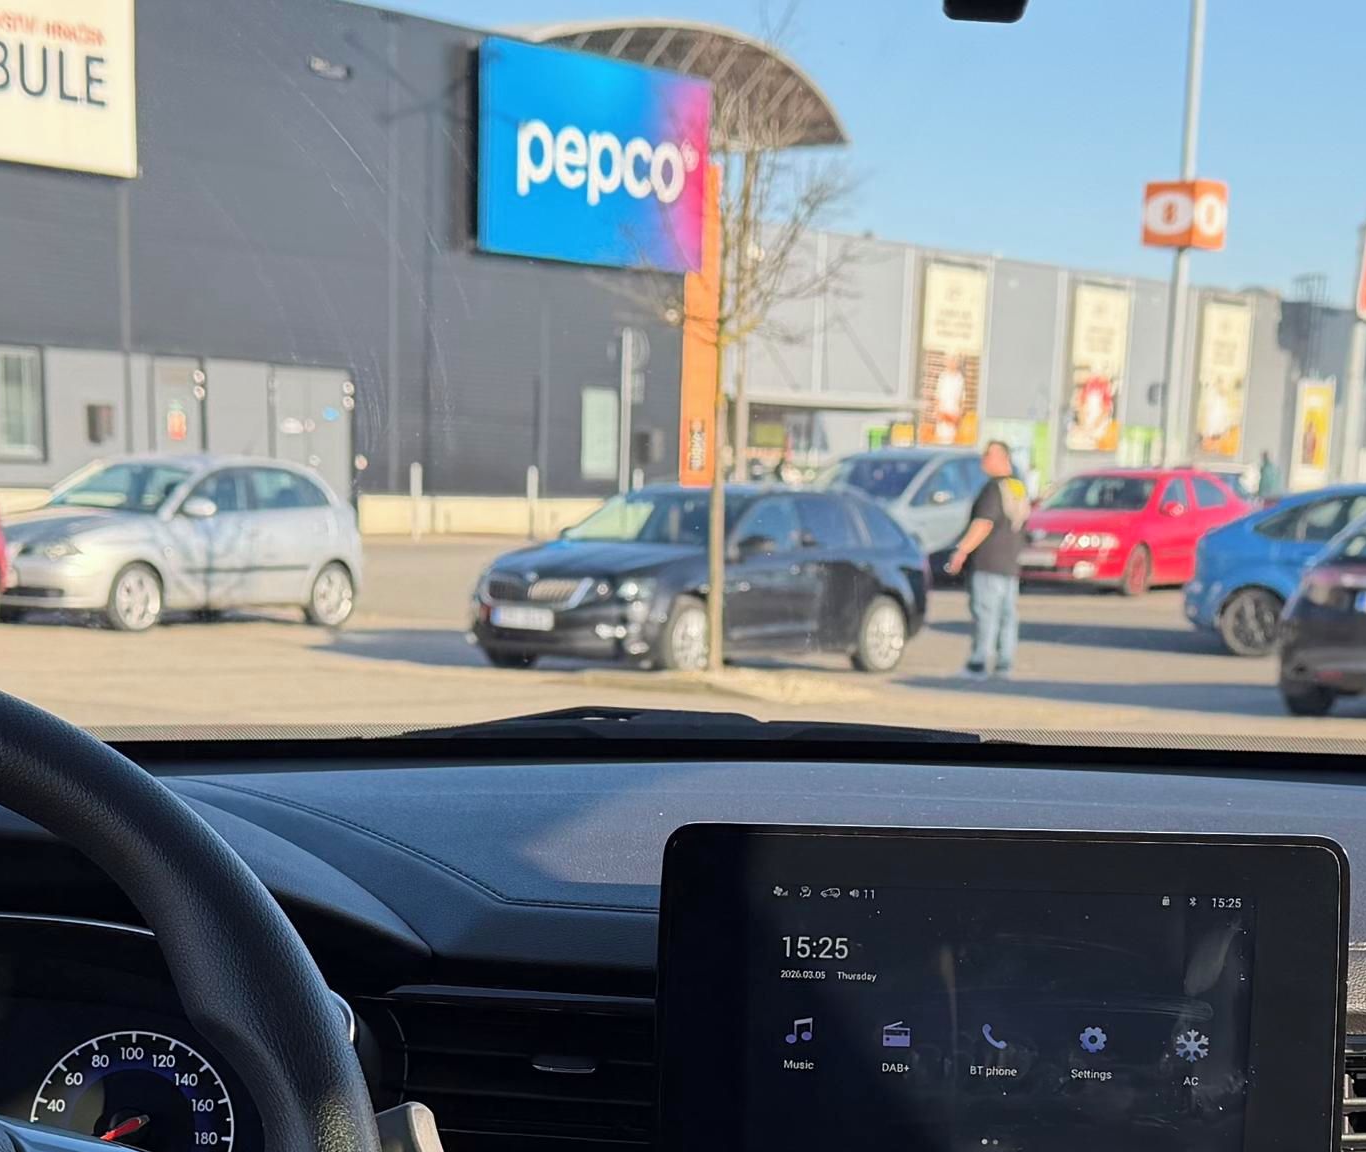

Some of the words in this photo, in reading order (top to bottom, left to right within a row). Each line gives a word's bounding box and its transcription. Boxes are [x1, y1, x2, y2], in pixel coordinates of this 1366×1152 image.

[516, 118, 685, 206] pepco
[863, 889, 875, 899] 11
[1212, 897, 1242, 908] 15:25
[782, 936, 848, 959] 15:25
[780, 969, 826, 979] 2026.03.05
[837, 971, 877, 982] Thursday
[120, 1047, 144, 1060] 100
[91, 1054, 109, 1067] 80
[152, 1054, 175, 1067] 120
[783, 1059, 814, 1070] Music
[882, 1063, 910, 1073] DAB+
[970, 1065, 983, 1075] BT
[986, 1066, 1018, 1077] phone
[64, 1072, 83, 1085] 60
[174, 1073, 198, 1086] 140
[1070, 1069, 1113, 1081] Settings
[1183, 1077, 1199, 1086] AC
[47, 1099, 65, 1112] 40
[191, 1098, 214, 1112] 160
[194, 1132, 218, 1145] 180
